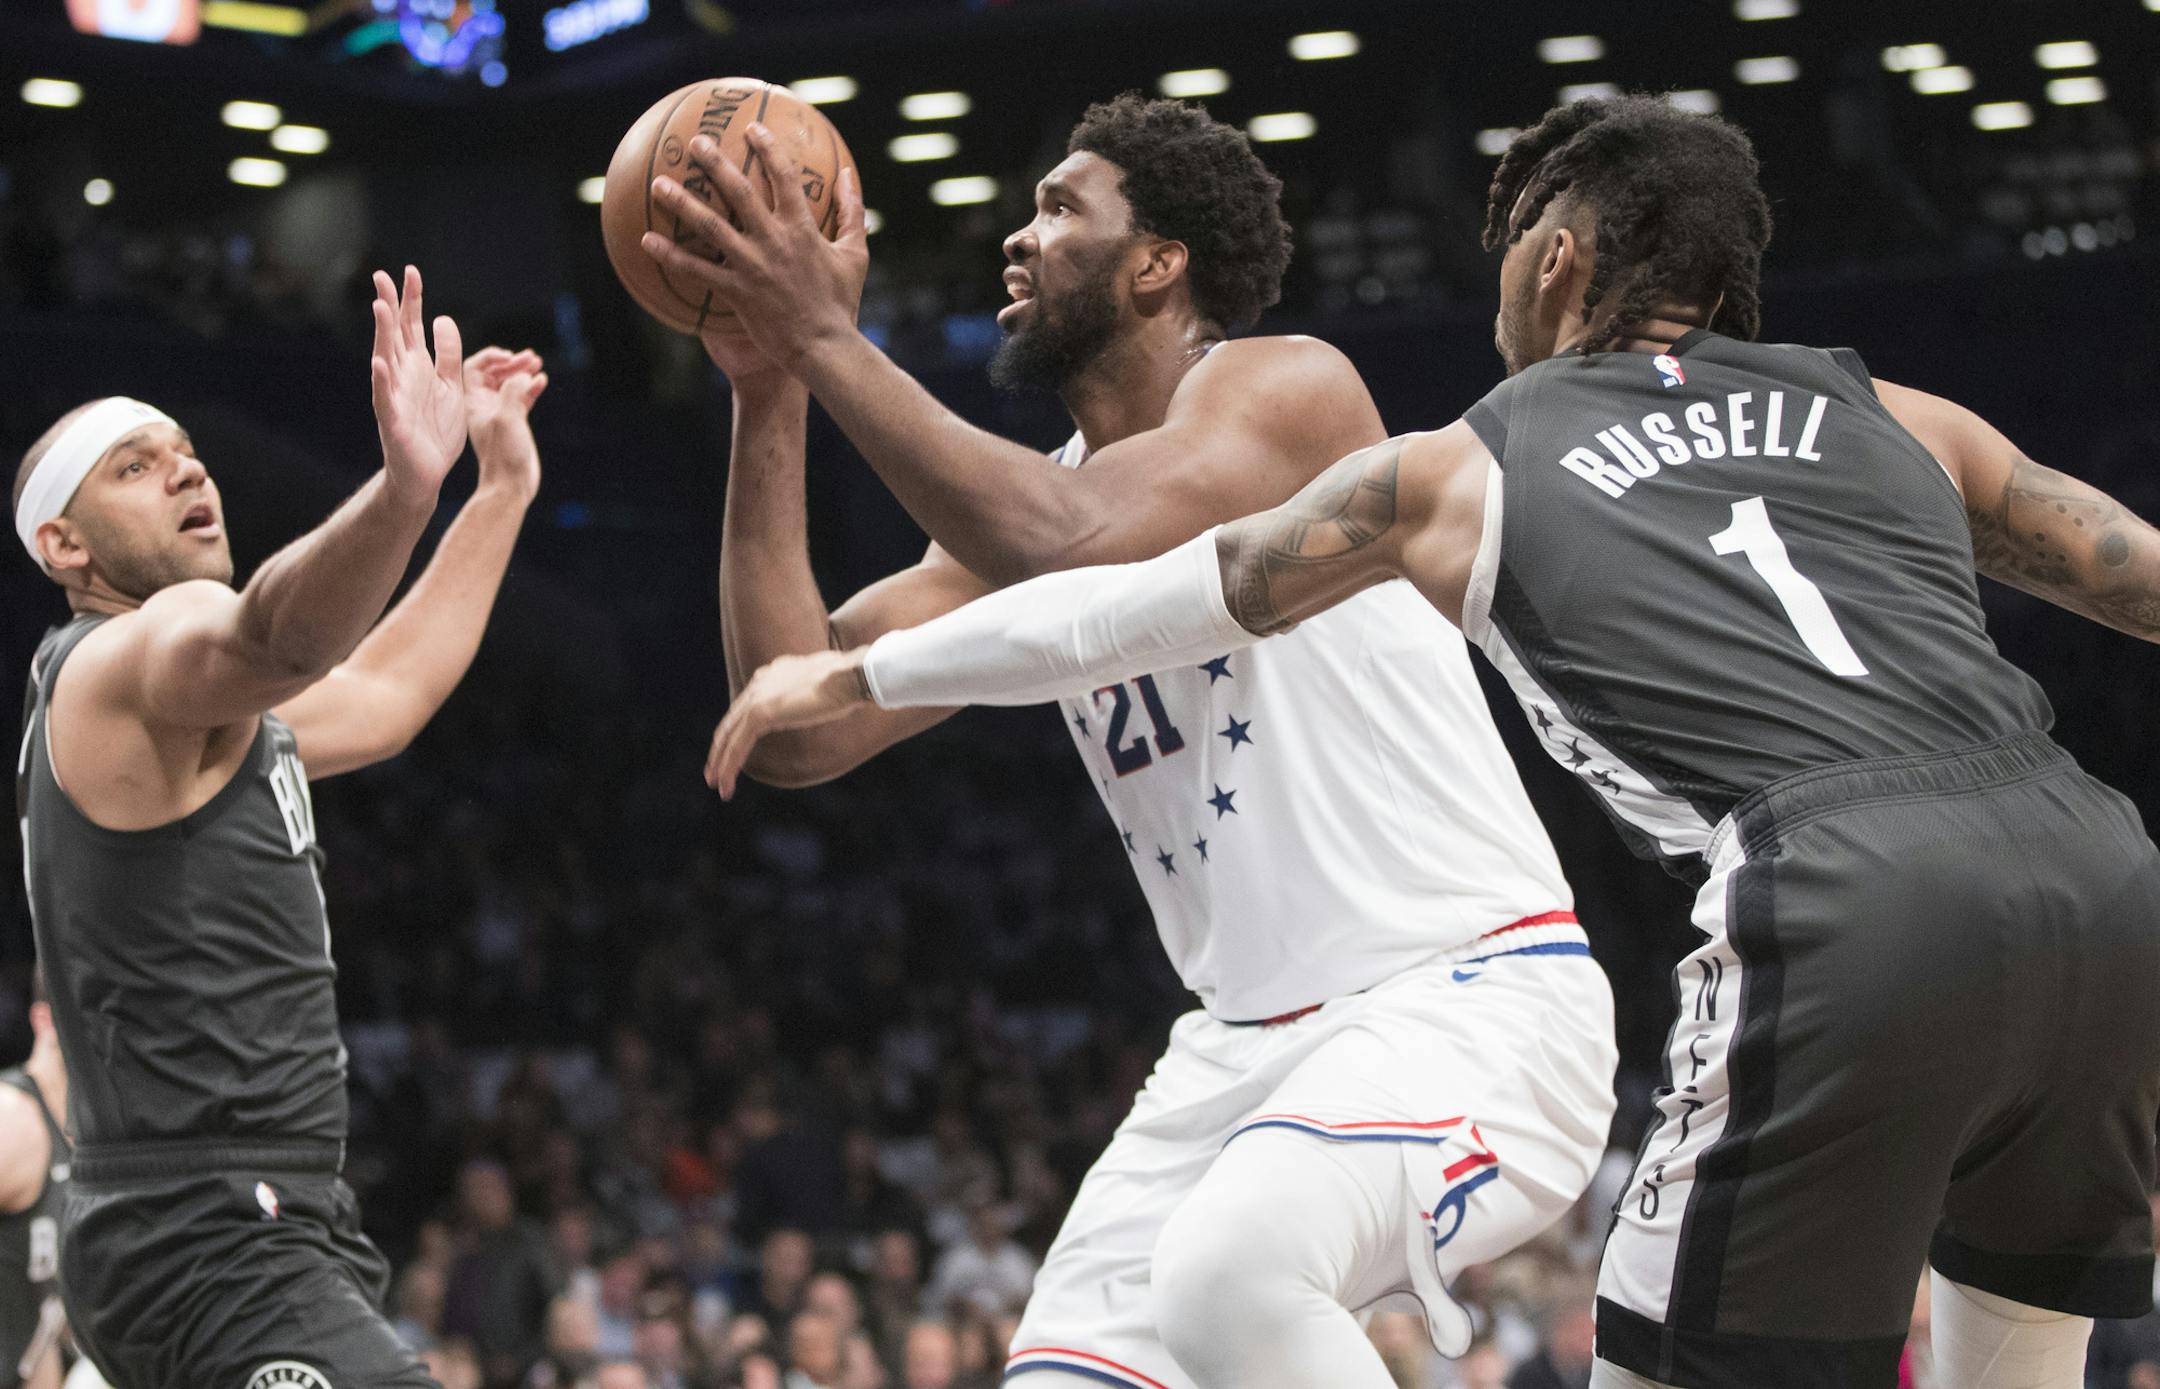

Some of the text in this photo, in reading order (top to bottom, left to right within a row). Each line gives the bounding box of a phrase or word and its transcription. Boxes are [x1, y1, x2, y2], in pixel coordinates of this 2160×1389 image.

[1558, 390, 1829, 499] RUSSELL
[1708, 496, 1870, 677] 1
[1092, 673, 1185, 778] 21
[1638, 956, 1724, 1221] NETS
